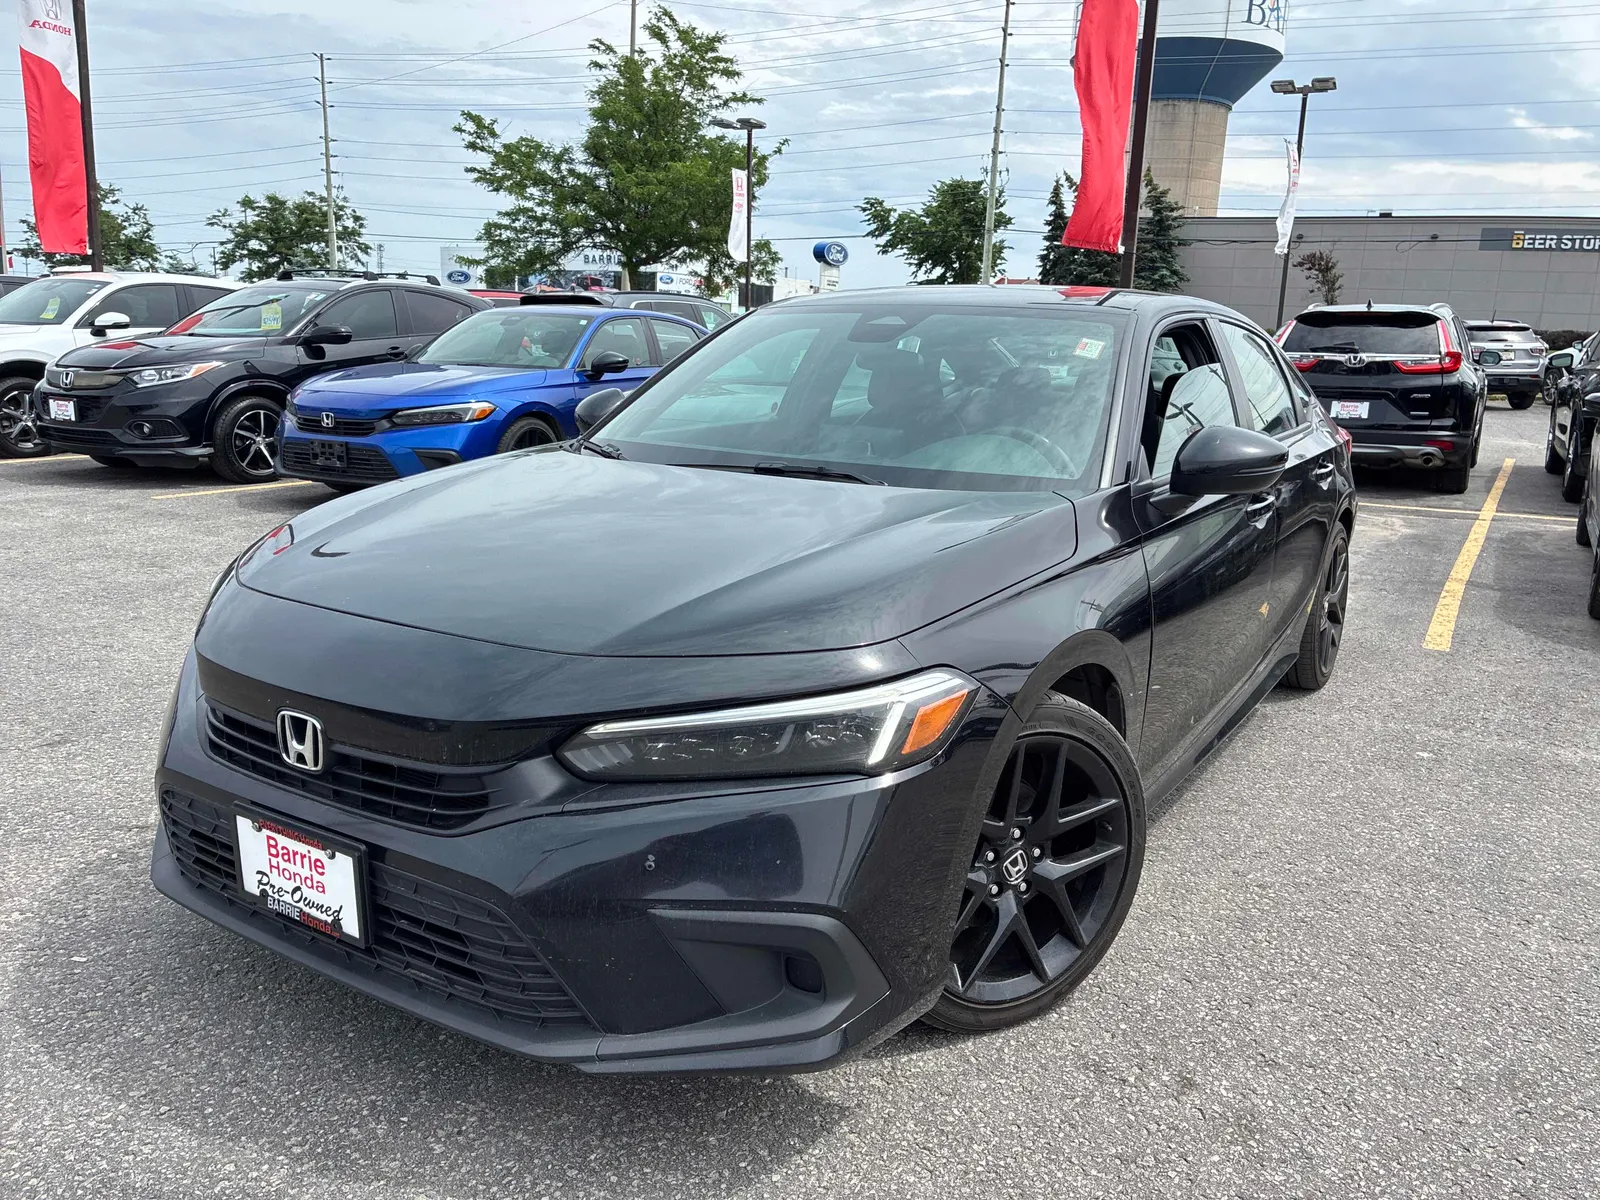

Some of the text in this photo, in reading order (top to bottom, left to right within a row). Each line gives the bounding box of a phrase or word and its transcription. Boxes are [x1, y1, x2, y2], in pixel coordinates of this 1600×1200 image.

[583, 254, 623, 265] BARRIE
[1511, 233, 1558, 249] BEER
[265, 834, 326, 877] Barrie
[268, 857, 326, 895] Honda
[255, 869, 344, 922] Pre-Owned
